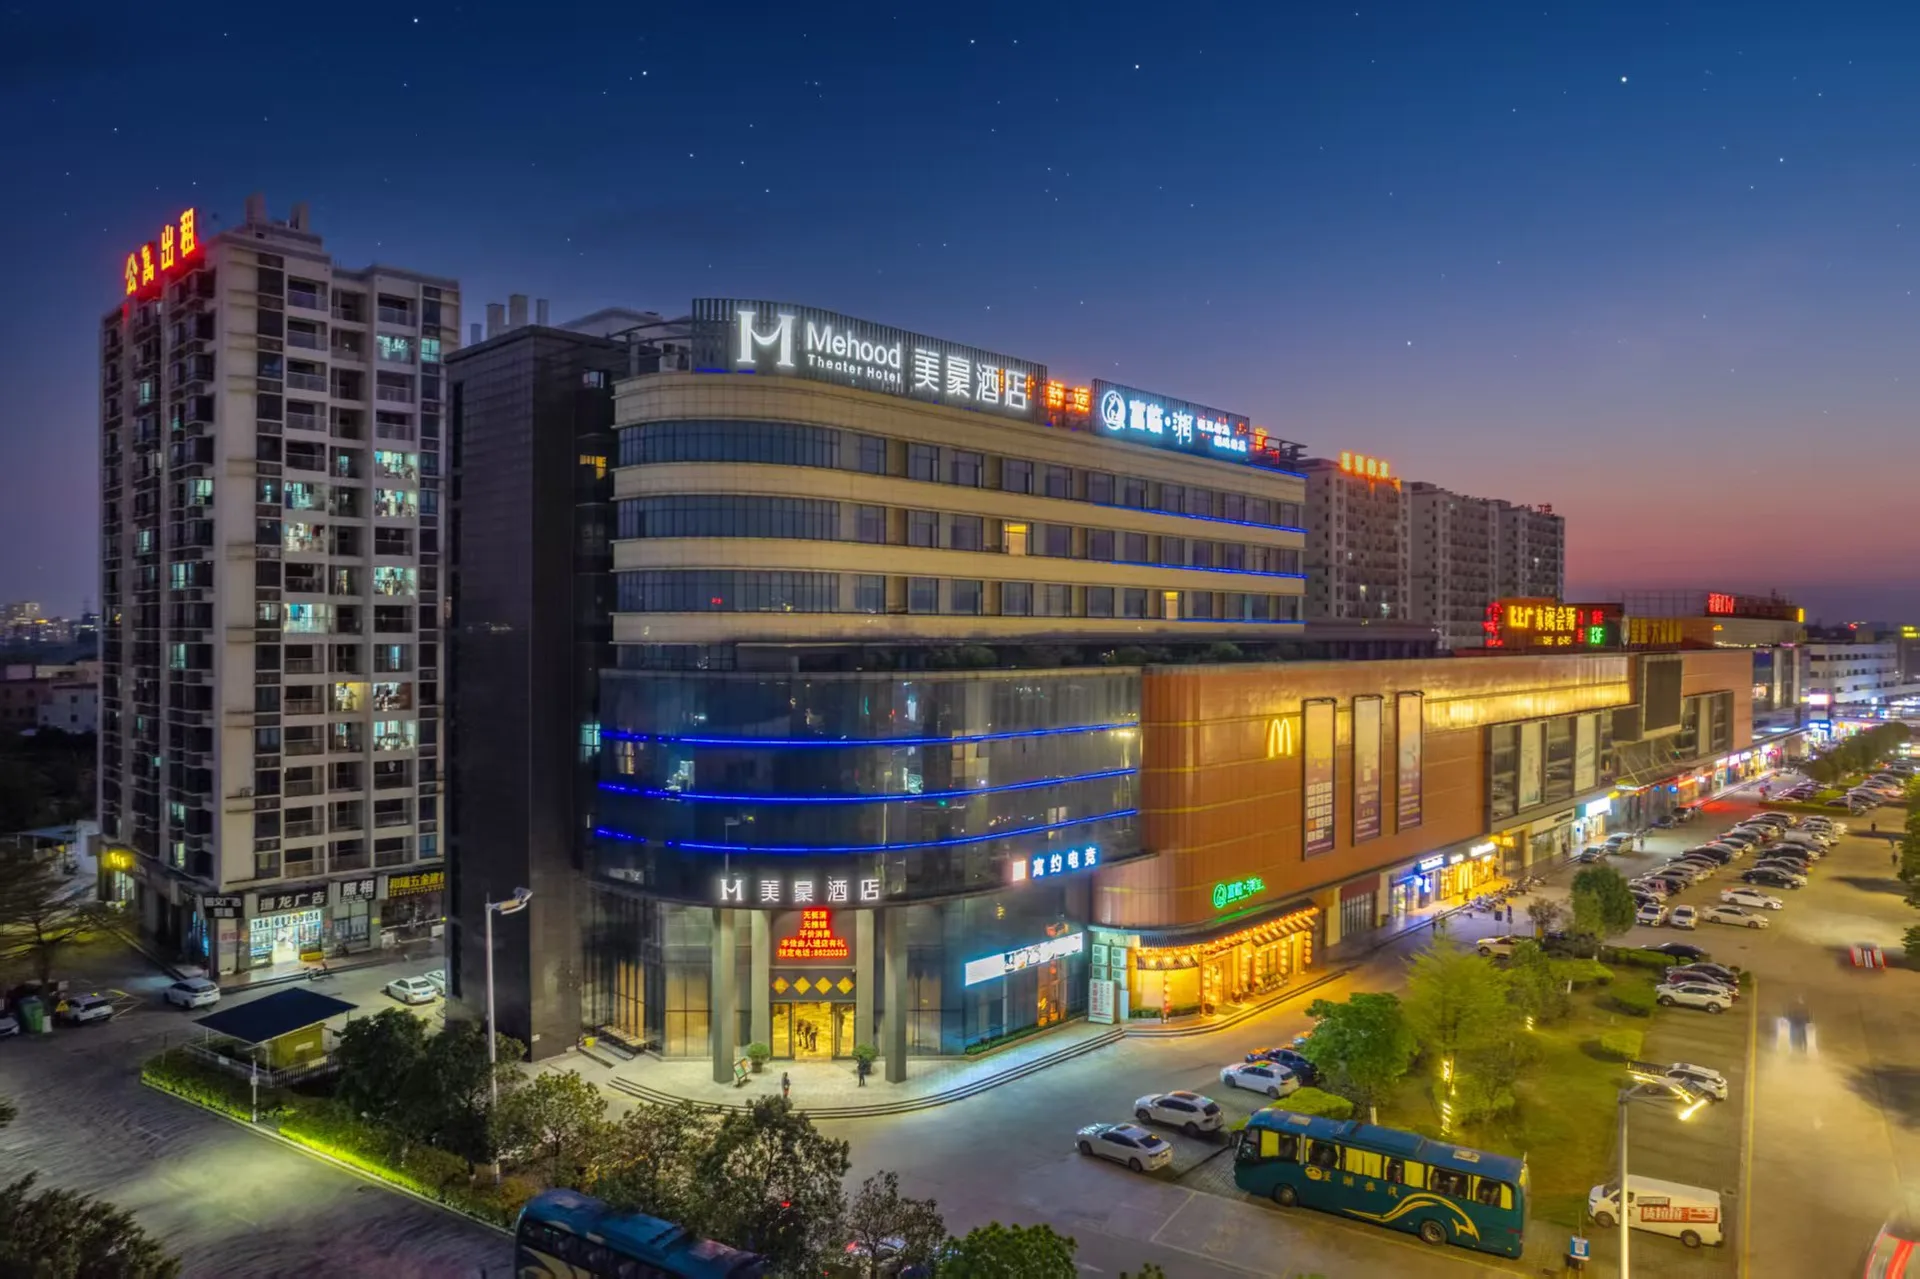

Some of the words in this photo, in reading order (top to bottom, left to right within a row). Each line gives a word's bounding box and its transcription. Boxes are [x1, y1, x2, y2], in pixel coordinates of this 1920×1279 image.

[807, 321, 901, 369] Mehood
[808, 353, 863, 376] Theater
[867, 366, 902, 384] Hotel
[915, 348, 1027, 411] 美豪酒店
[760, 876, 880, 902] 美豪酒店
